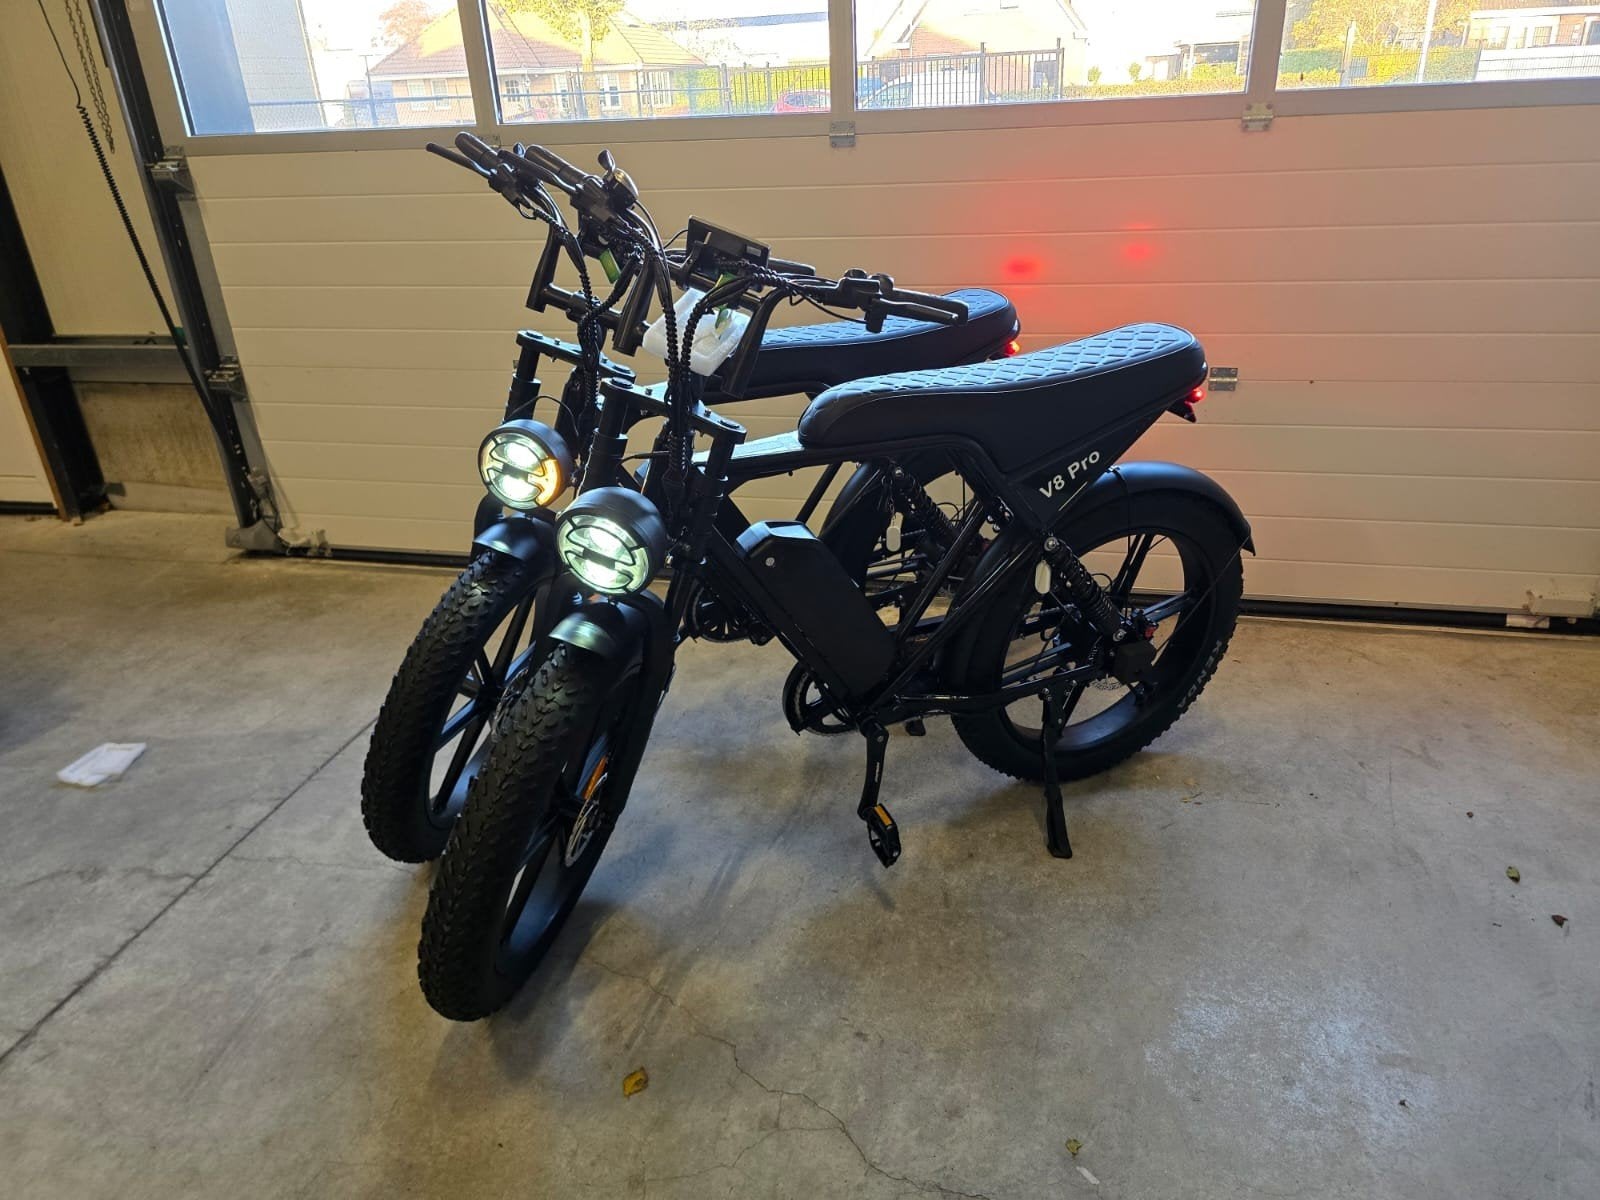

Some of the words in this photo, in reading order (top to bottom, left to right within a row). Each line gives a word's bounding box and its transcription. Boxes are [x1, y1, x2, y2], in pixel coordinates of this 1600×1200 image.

[1039, 475, 1065, 498] V8
[1067, 451, 1100, 479] Pro
[1177, 639, 1223, 709] KENDA
